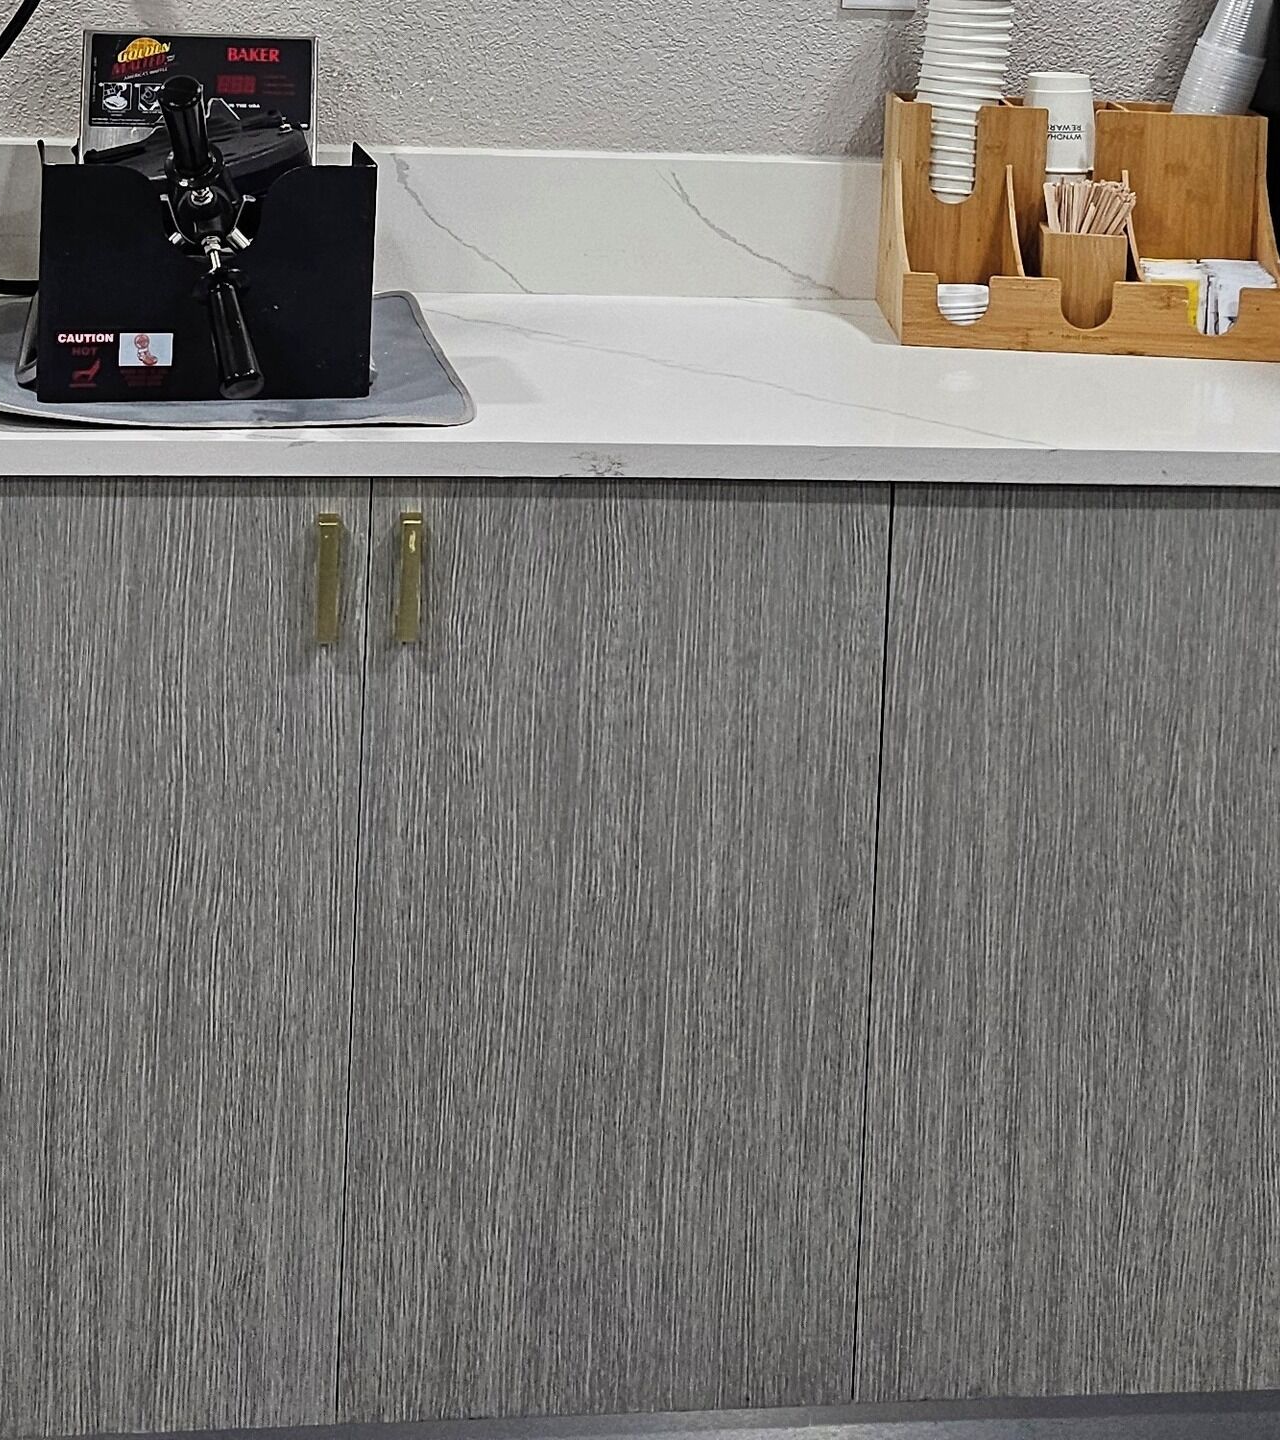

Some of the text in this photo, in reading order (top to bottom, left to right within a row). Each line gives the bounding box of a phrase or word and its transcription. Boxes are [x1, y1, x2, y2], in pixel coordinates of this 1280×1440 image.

[117, 41, 171, 63] GOLDEN
[227, 47, 280, 62] BAKER
[57, 333, 115, 343] CAUTION
[71, 347, 98, 356] HOT
